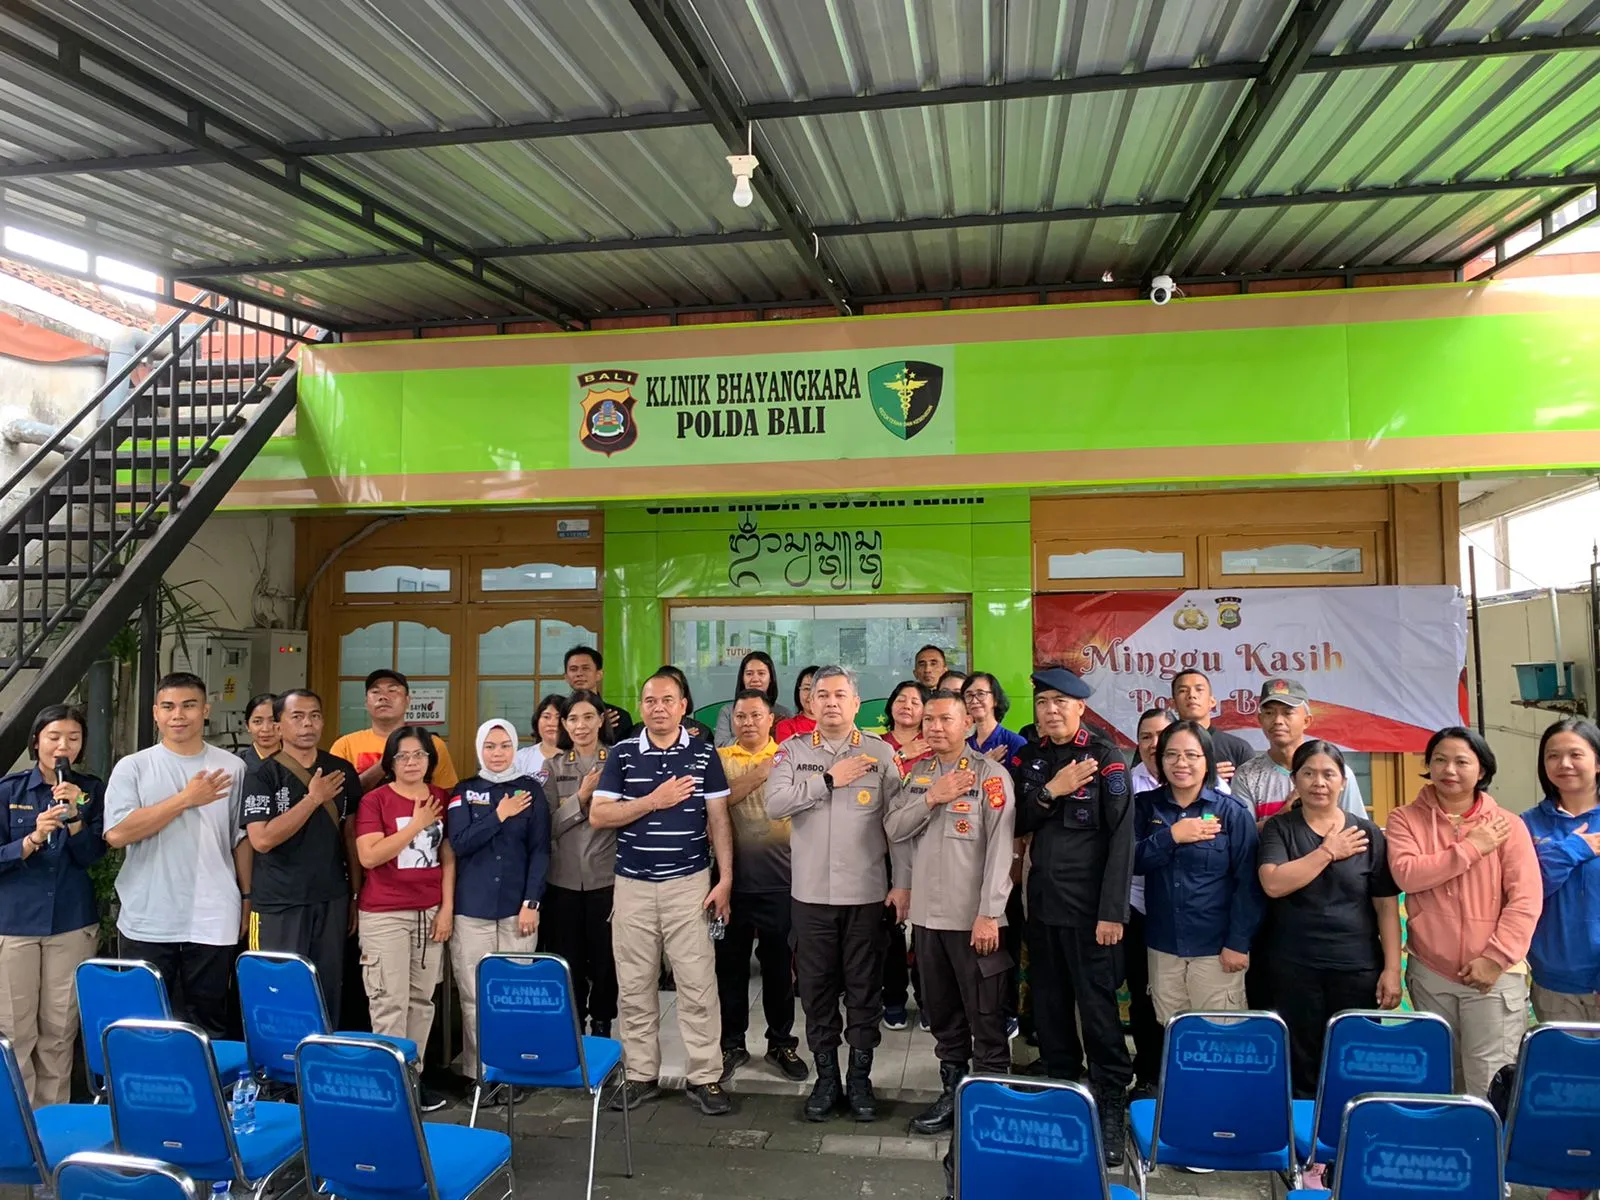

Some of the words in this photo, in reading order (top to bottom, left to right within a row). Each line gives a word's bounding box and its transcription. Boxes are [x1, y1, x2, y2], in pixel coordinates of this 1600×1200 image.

[584, 372, 631, 383] BALI
[646, 374, 711, 407] KLINIK
[716, 367, 861, 404] BHAYANGKARA
[676, 409, 760, 438] POLDA
[767, 406, 826, 436] BALI
[1080, 637, 1223, 680] Minggu
[1235, 642, 1344, 677] Kasih
[421, 701, 434, 711] NO
[405, 711, 414, 719] TO
[416, 711, 440, 719] DRUGS
[796, 764, 824, 772] ARSDO
[503, 984, 549, 997] YANMA
[493, 995, 531, 1005] POLDA
[532, 997, 559, 1006] BALI
[1183, 1051, 1232, 1063] POLDA
[1235, 1054, 1269, 1065] BALI
[993, 1115, 1063, 1138] YANMA
[980, 1128, 1036, 1147] POLDA
[1038, 1136, 1079, 1151] BALI
[1380, 1151, 1458, 1170] YANMA
